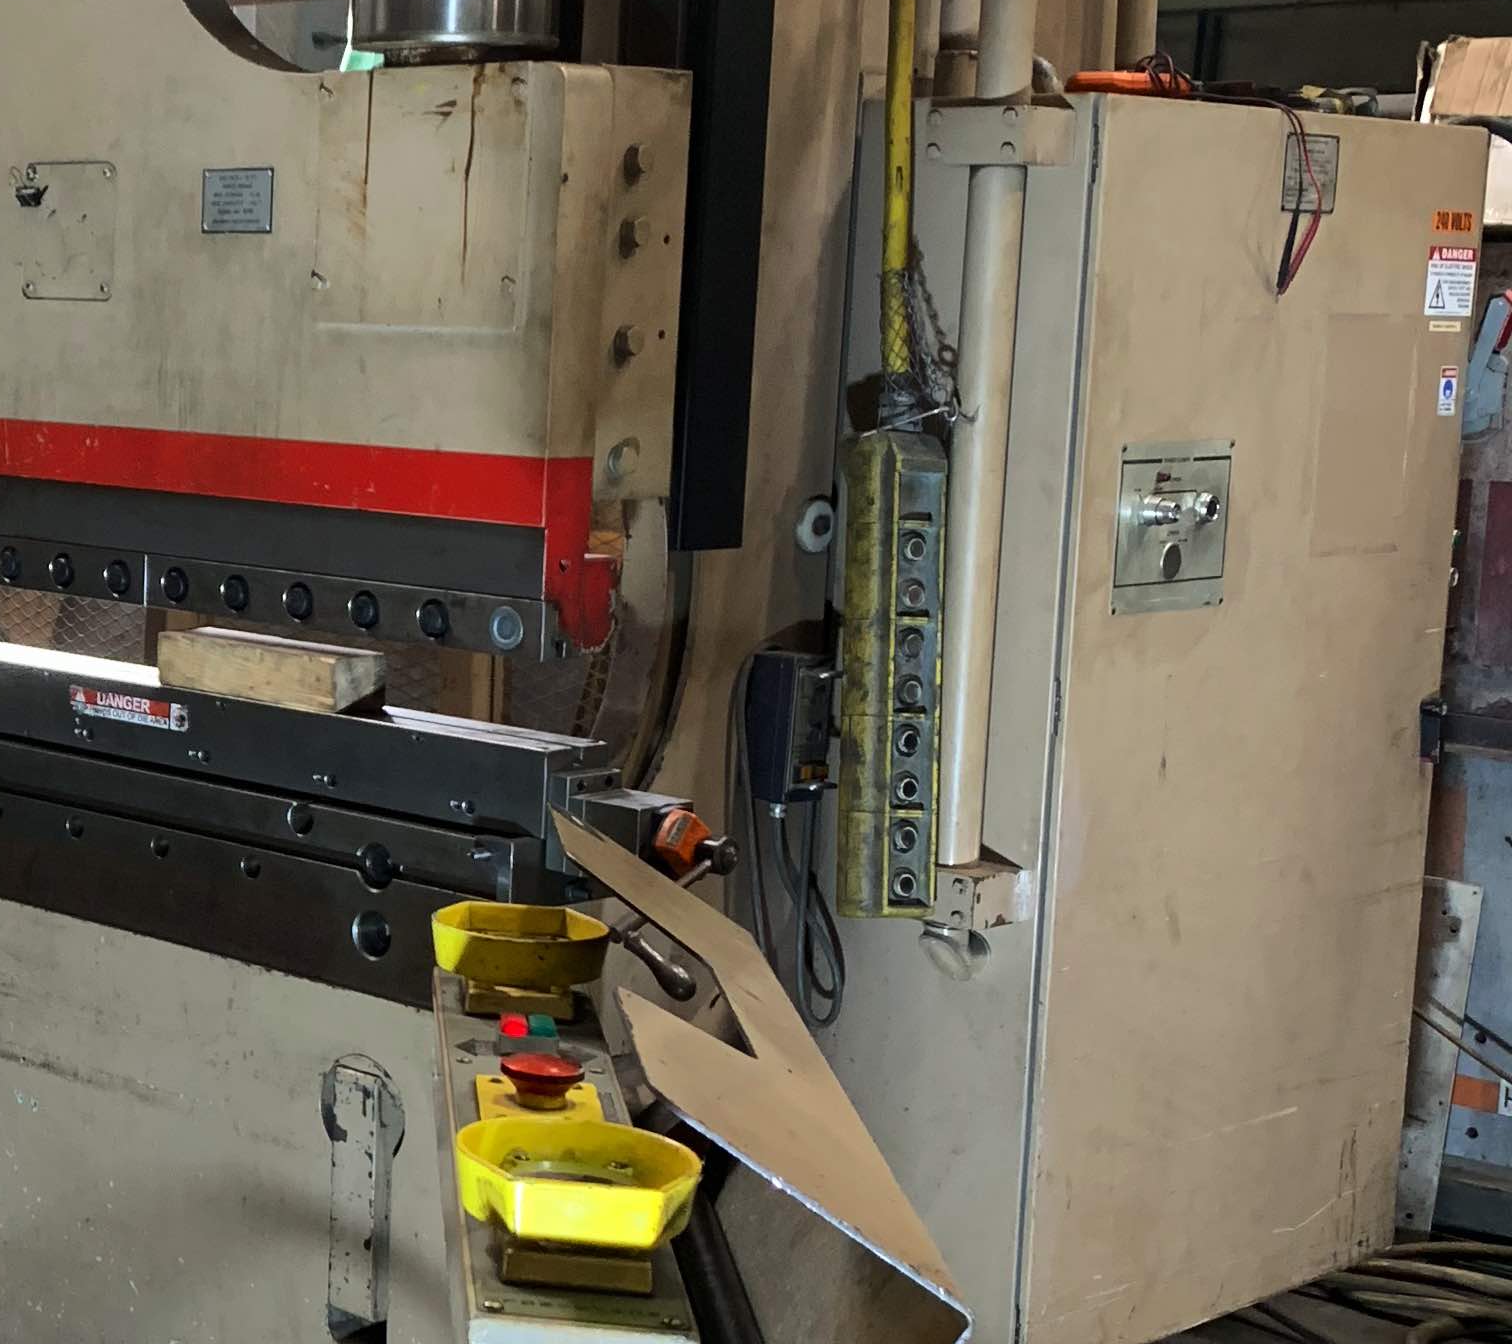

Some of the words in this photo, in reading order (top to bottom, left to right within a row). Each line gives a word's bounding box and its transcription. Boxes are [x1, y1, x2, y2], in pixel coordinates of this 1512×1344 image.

[1451, 212, 1473, 231] VOLTS
[1441, 247, 1474, 260] DANGER
[96, 691, 150, 713] DANGER
